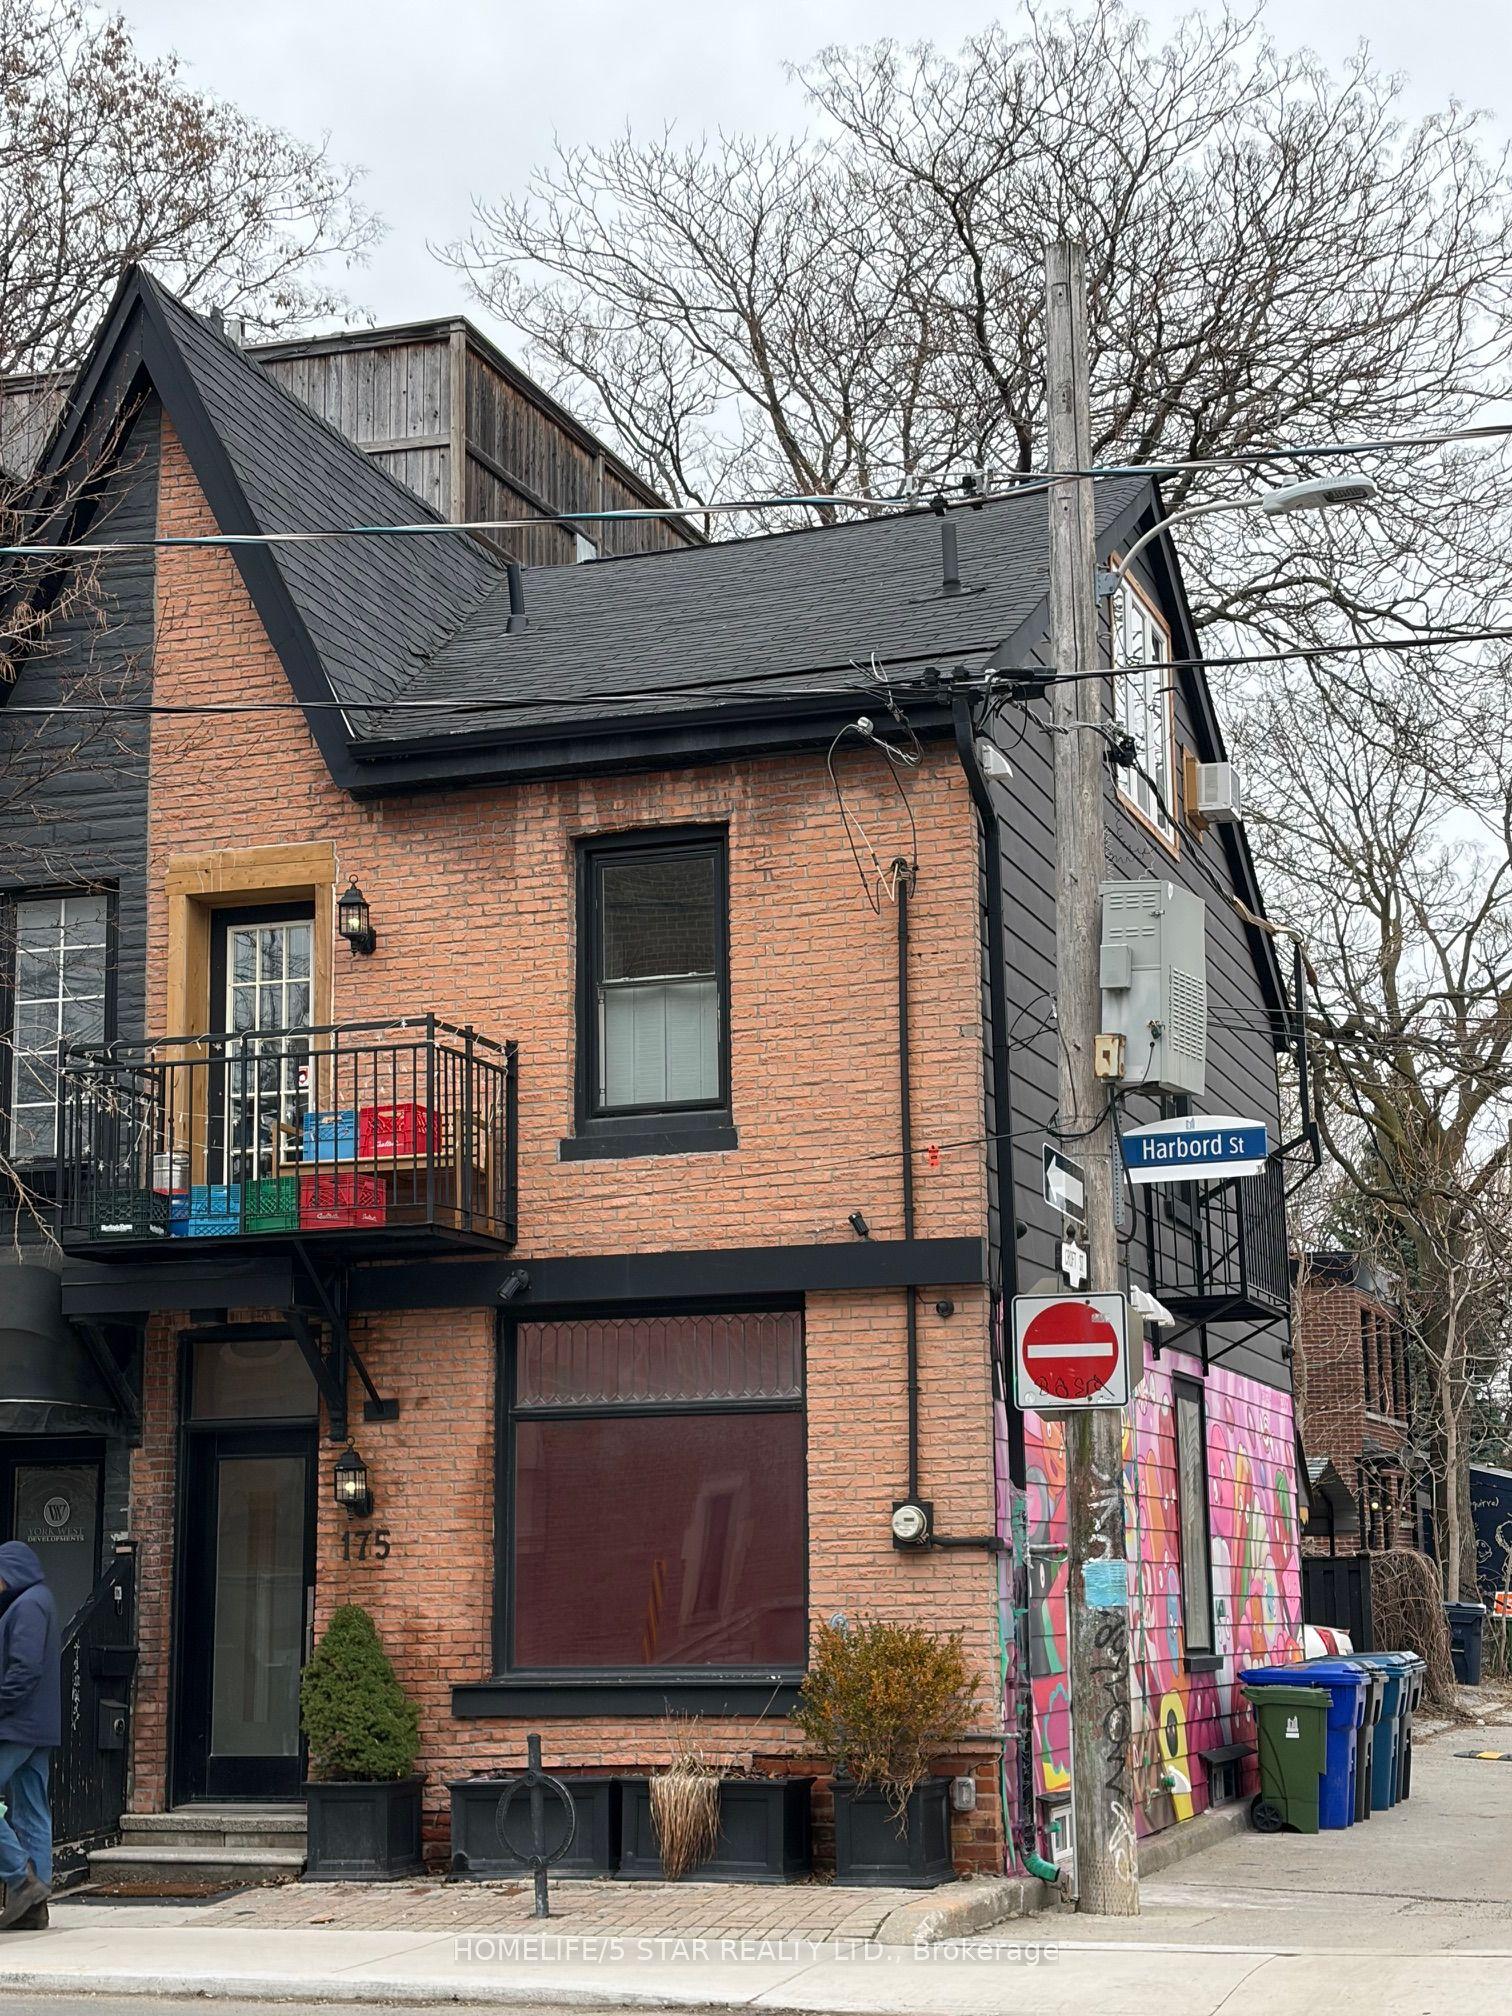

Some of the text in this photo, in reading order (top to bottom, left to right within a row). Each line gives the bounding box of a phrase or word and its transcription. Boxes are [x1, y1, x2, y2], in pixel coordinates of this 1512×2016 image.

[1142, 1133, 1245, 1160] Harbord St
[27, 1527, 85, 1536] YORK WEST
[27, 1534, 85, 1543] DEVELOPMENTS
[341, 1530, 391, 1560] 175
